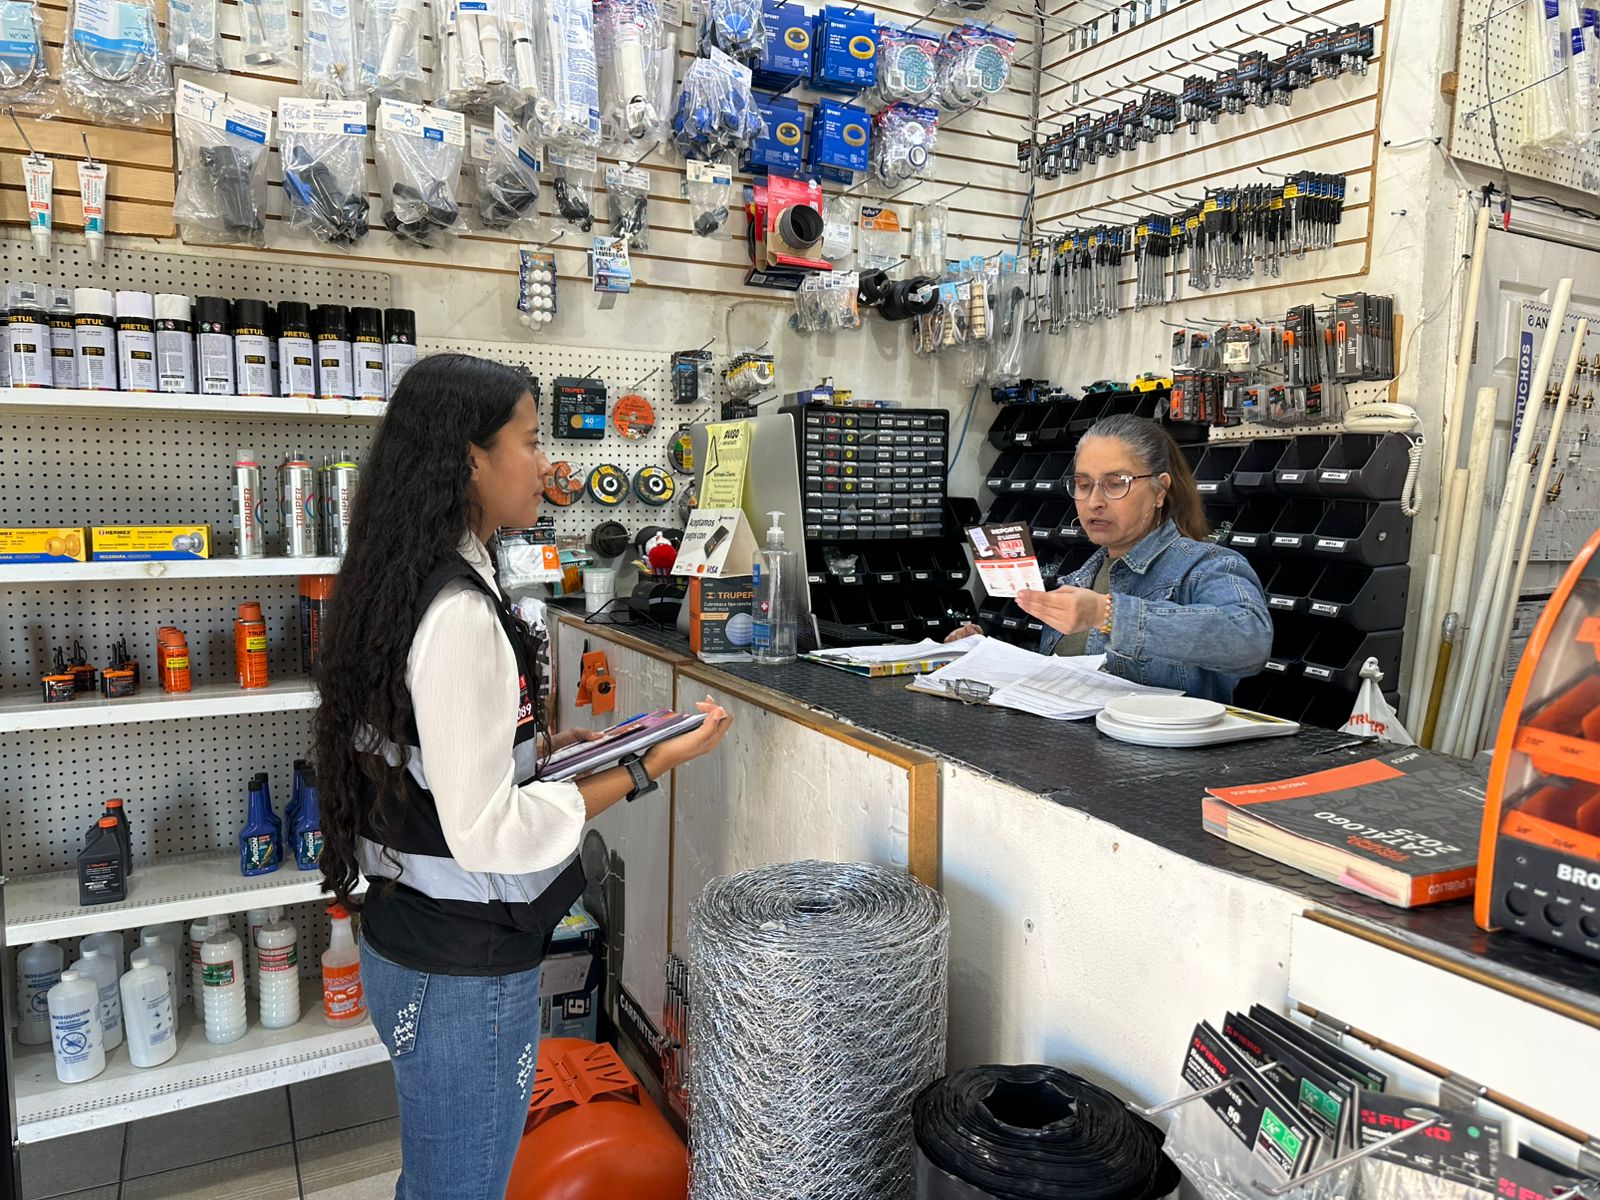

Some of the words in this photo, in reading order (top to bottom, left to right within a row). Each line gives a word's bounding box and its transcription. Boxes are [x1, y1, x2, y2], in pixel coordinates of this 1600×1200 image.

[120, 323, 151, 332] PRETUL
[236, 328, 264, 336] PRETUL
[283, 331, 311, 339] PRETUL
[1512, 344, 1531, 453] ARTUCHOS
[584, 417, 595, 425] 40
[723, 428, 740, 440] AVISO
[244, 487, 253, 528] TRUPER
[295, 487, 304, 528] TRUPER
[341, 487, 350, 528] TRUPER
[689, 517, 715, 528] Aceptamos
[707, 565, 718, 574] VISA
[1279, 781, 1308, 790] PRECIO
[1314, 811, 1438, 857] CATÁLOGO
[1388, 828, 1461, 854] 2025
[52, 1008, 90, 1019] MOSQUICIDA
[1201, 1045, 1228, 1075] FIERO
[1227, 1105, 1241, 1124] 50
